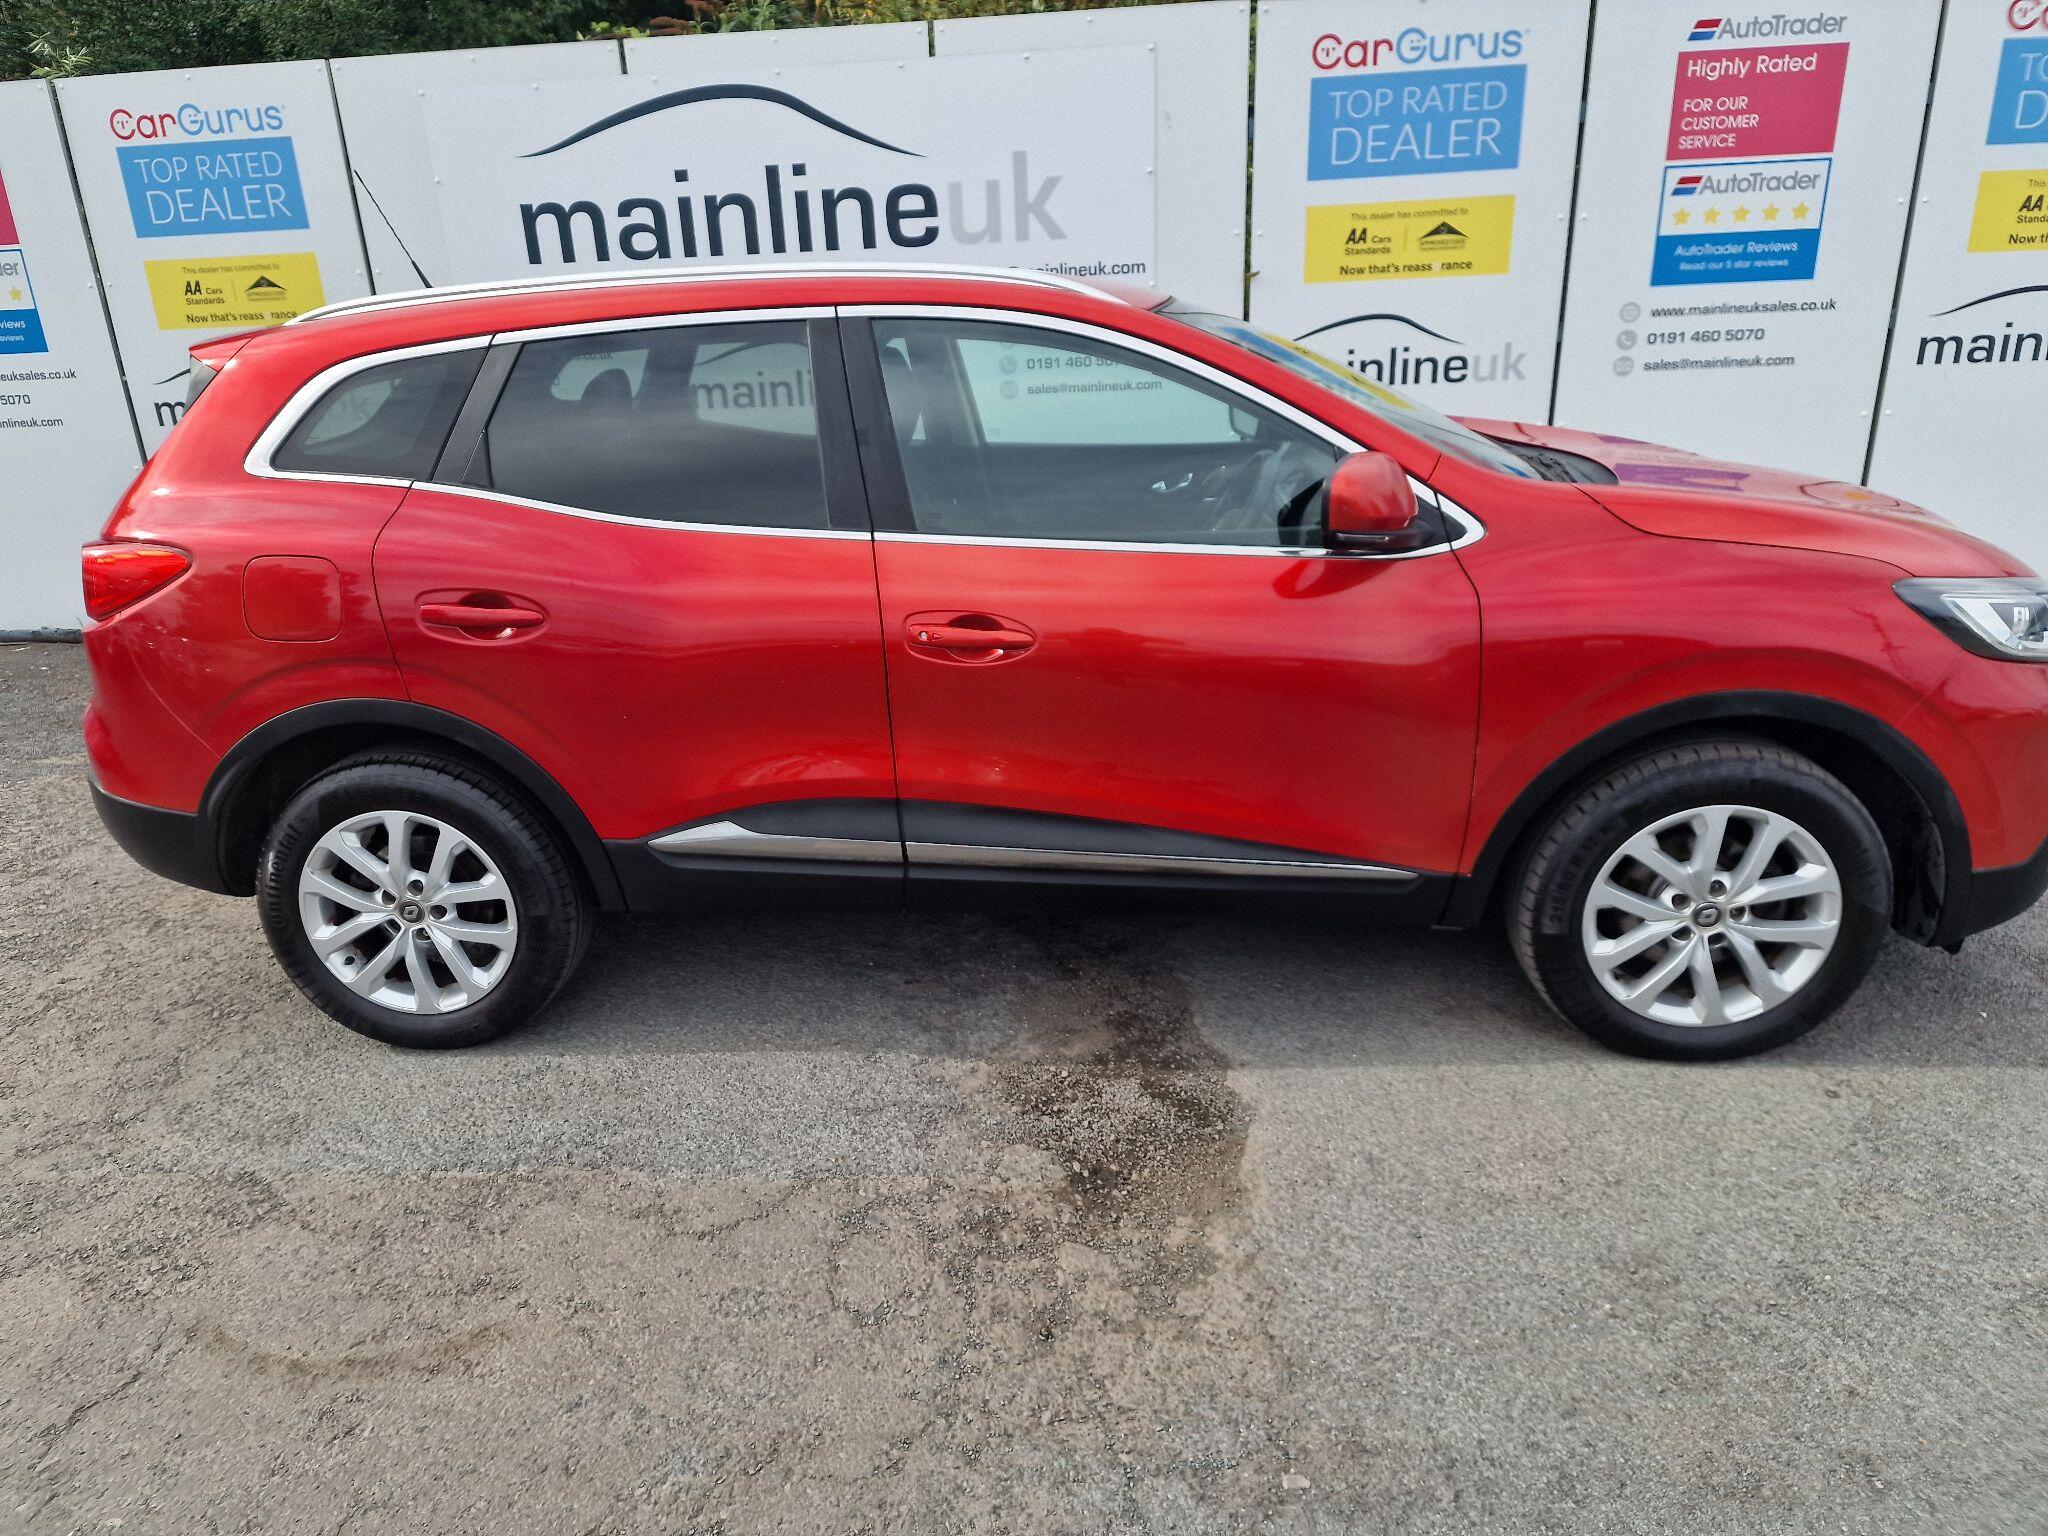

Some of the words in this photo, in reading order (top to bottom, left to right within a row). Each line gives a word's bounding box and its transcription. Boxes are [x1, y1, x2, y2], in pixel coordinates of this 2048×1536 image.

[1717, 12, 1847, 39] AutoTrader
[1312, 27, 1523, 70] CarGurus
[1687, 56, 1751, 81] Highly
[1756, 52, 1818, 74] Rated
[1329, 88, 1394, 119] TOP
[1402, 81, 1508, 114] RATED
[1683, 98, 1713, 112] FOR
[1716, 96, 1749, 110] OUR
[109, 103, 283, 140] CarGurus
[1681, 114, 1760, 131] CUSTOMER
[1331, 117, 1501, 166] DEALER
[1678, 133, 1737, 149] SERVICE
[133, 156, 188, 184] TOP
[195, 151, 283, 180] RATED
[1698, 170, 1820, 195] AutoTrader
[146, 183, 292, 225] DEALER
[519, 150, 1069, 265] mainlineuk
[2019, 194, 2044, 211] AA
[1345, 227, 1367, 244] AA
[1371, 235, 1392, 244] Cars
[2009, 232, 2037, 244] Now
[1344, 246, 1391, 256] Standards
[1674, 243, 1744, 257] AutoTrader
[1746, 241, 1798, 253] Reviews
[1339, 264, 1366, 276] Now
[1368, 262, 1400, 274] that's
[184, 280, 202, 296] AA
[205, 287, 223, 295] Cars
[186, 296, 225, 305] Standards
[186, 313, 209, 323] Now
[210, 310, 237, 322] that's
[1647, 331, 1685, 345] 0191
[1690, 329, 1721, 342] 460
[1725, 328, 1765, 341] 5070
